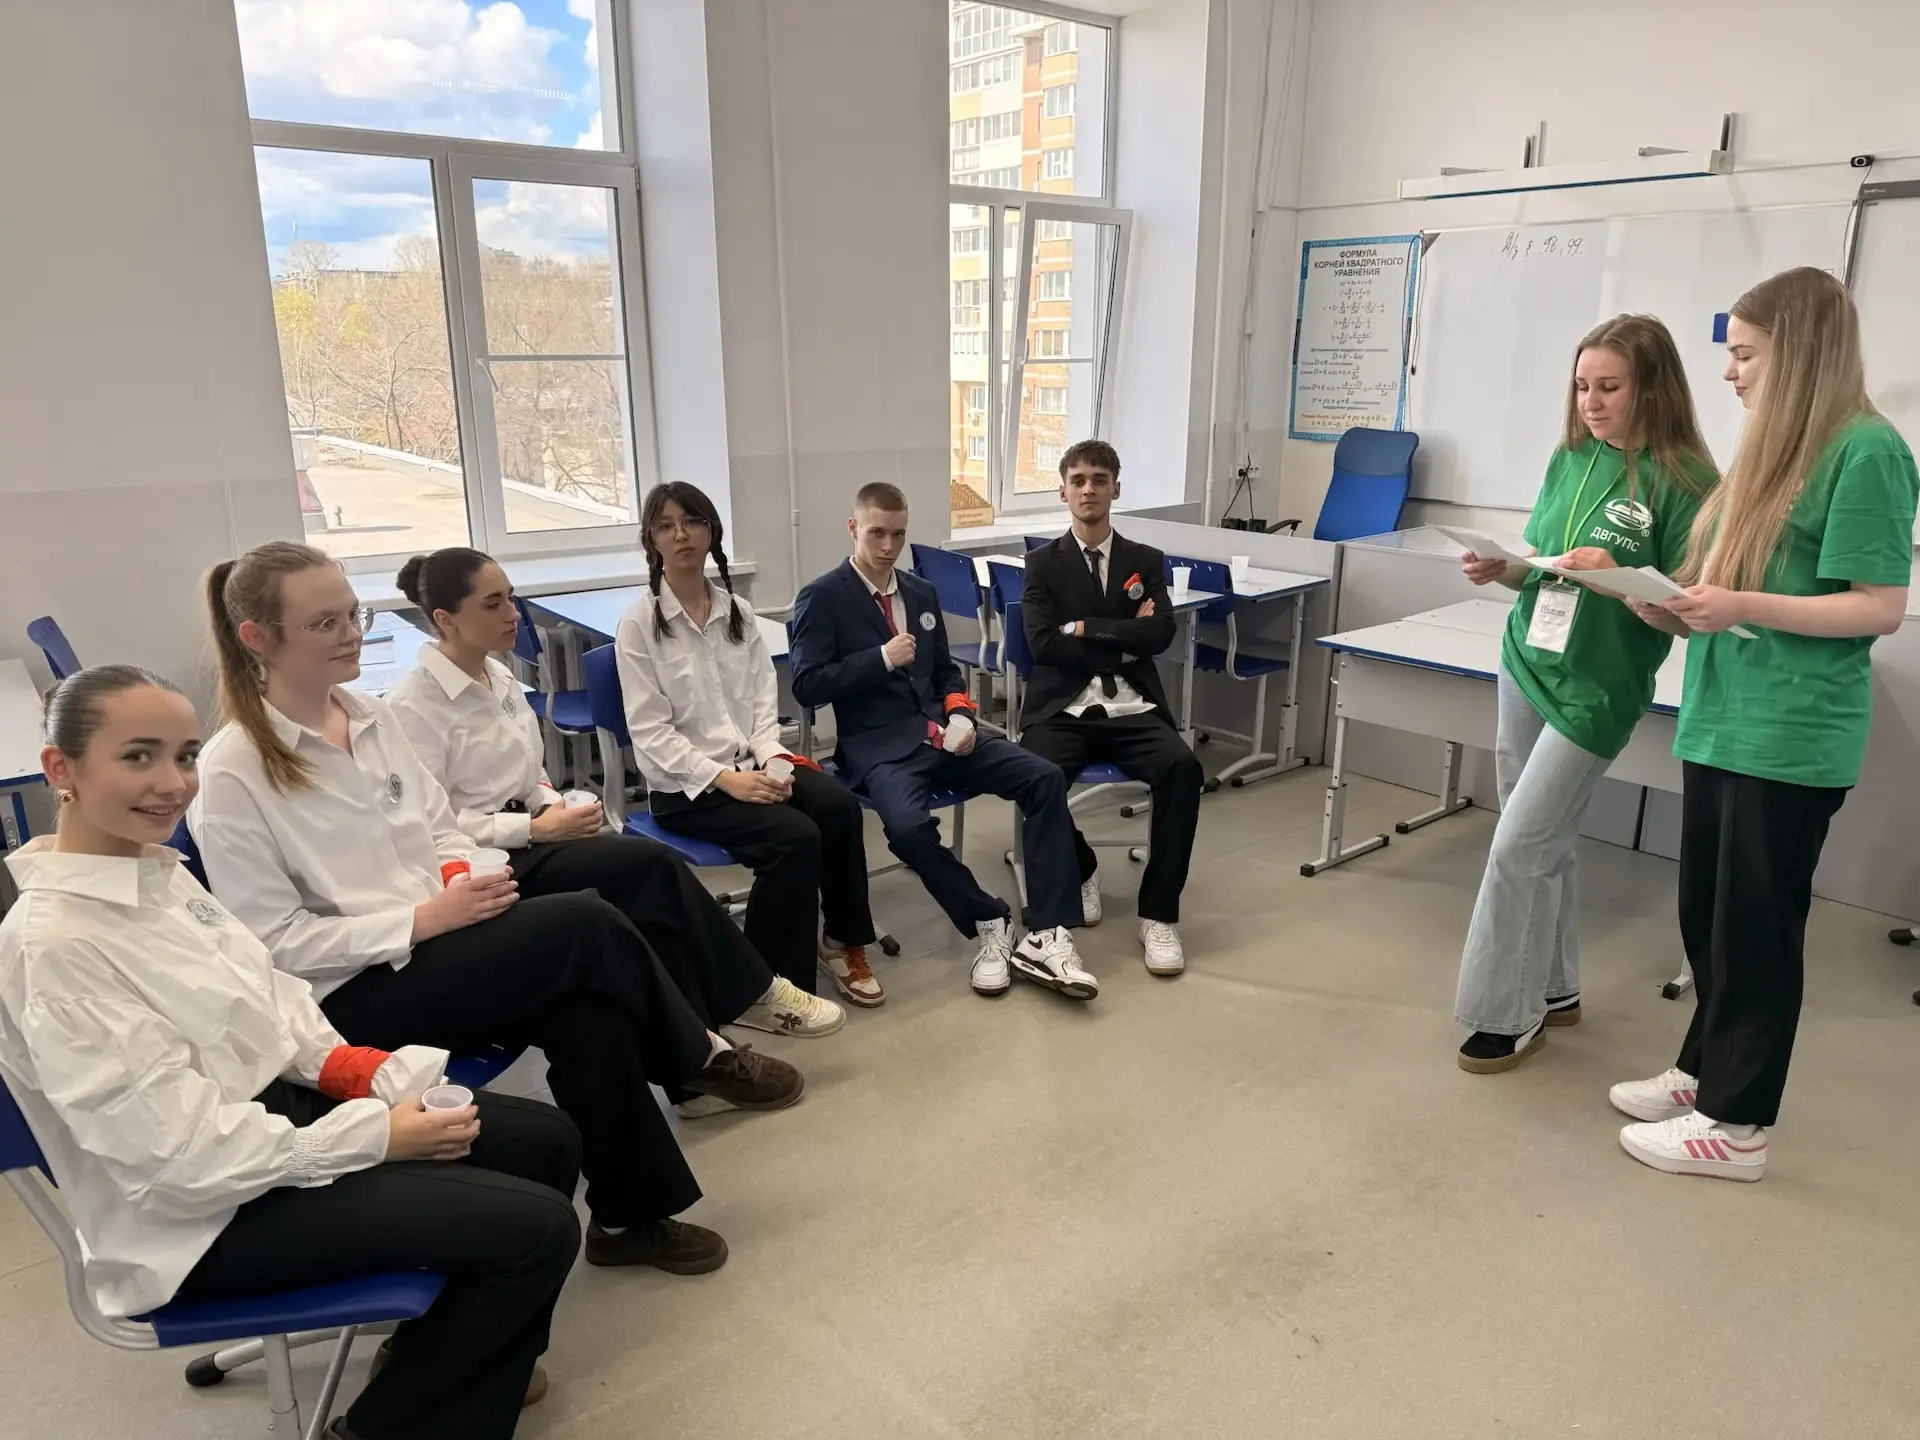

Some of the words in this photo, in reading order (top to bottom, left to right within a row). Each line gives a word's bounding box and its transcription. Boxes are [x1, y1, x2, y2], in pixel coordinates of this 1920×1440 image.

[1339, 249, 1378, 260] ФОРМУЛА
[1314, 259, 1345, 269] КОРНЕЙ
[1346, 257, 1404, 268] КВАДРАТНОГО
[1333, 267, 1380, 278] УРАВНЕНИЯ
[1590, 526, 1640, 553] ДВГУПС
